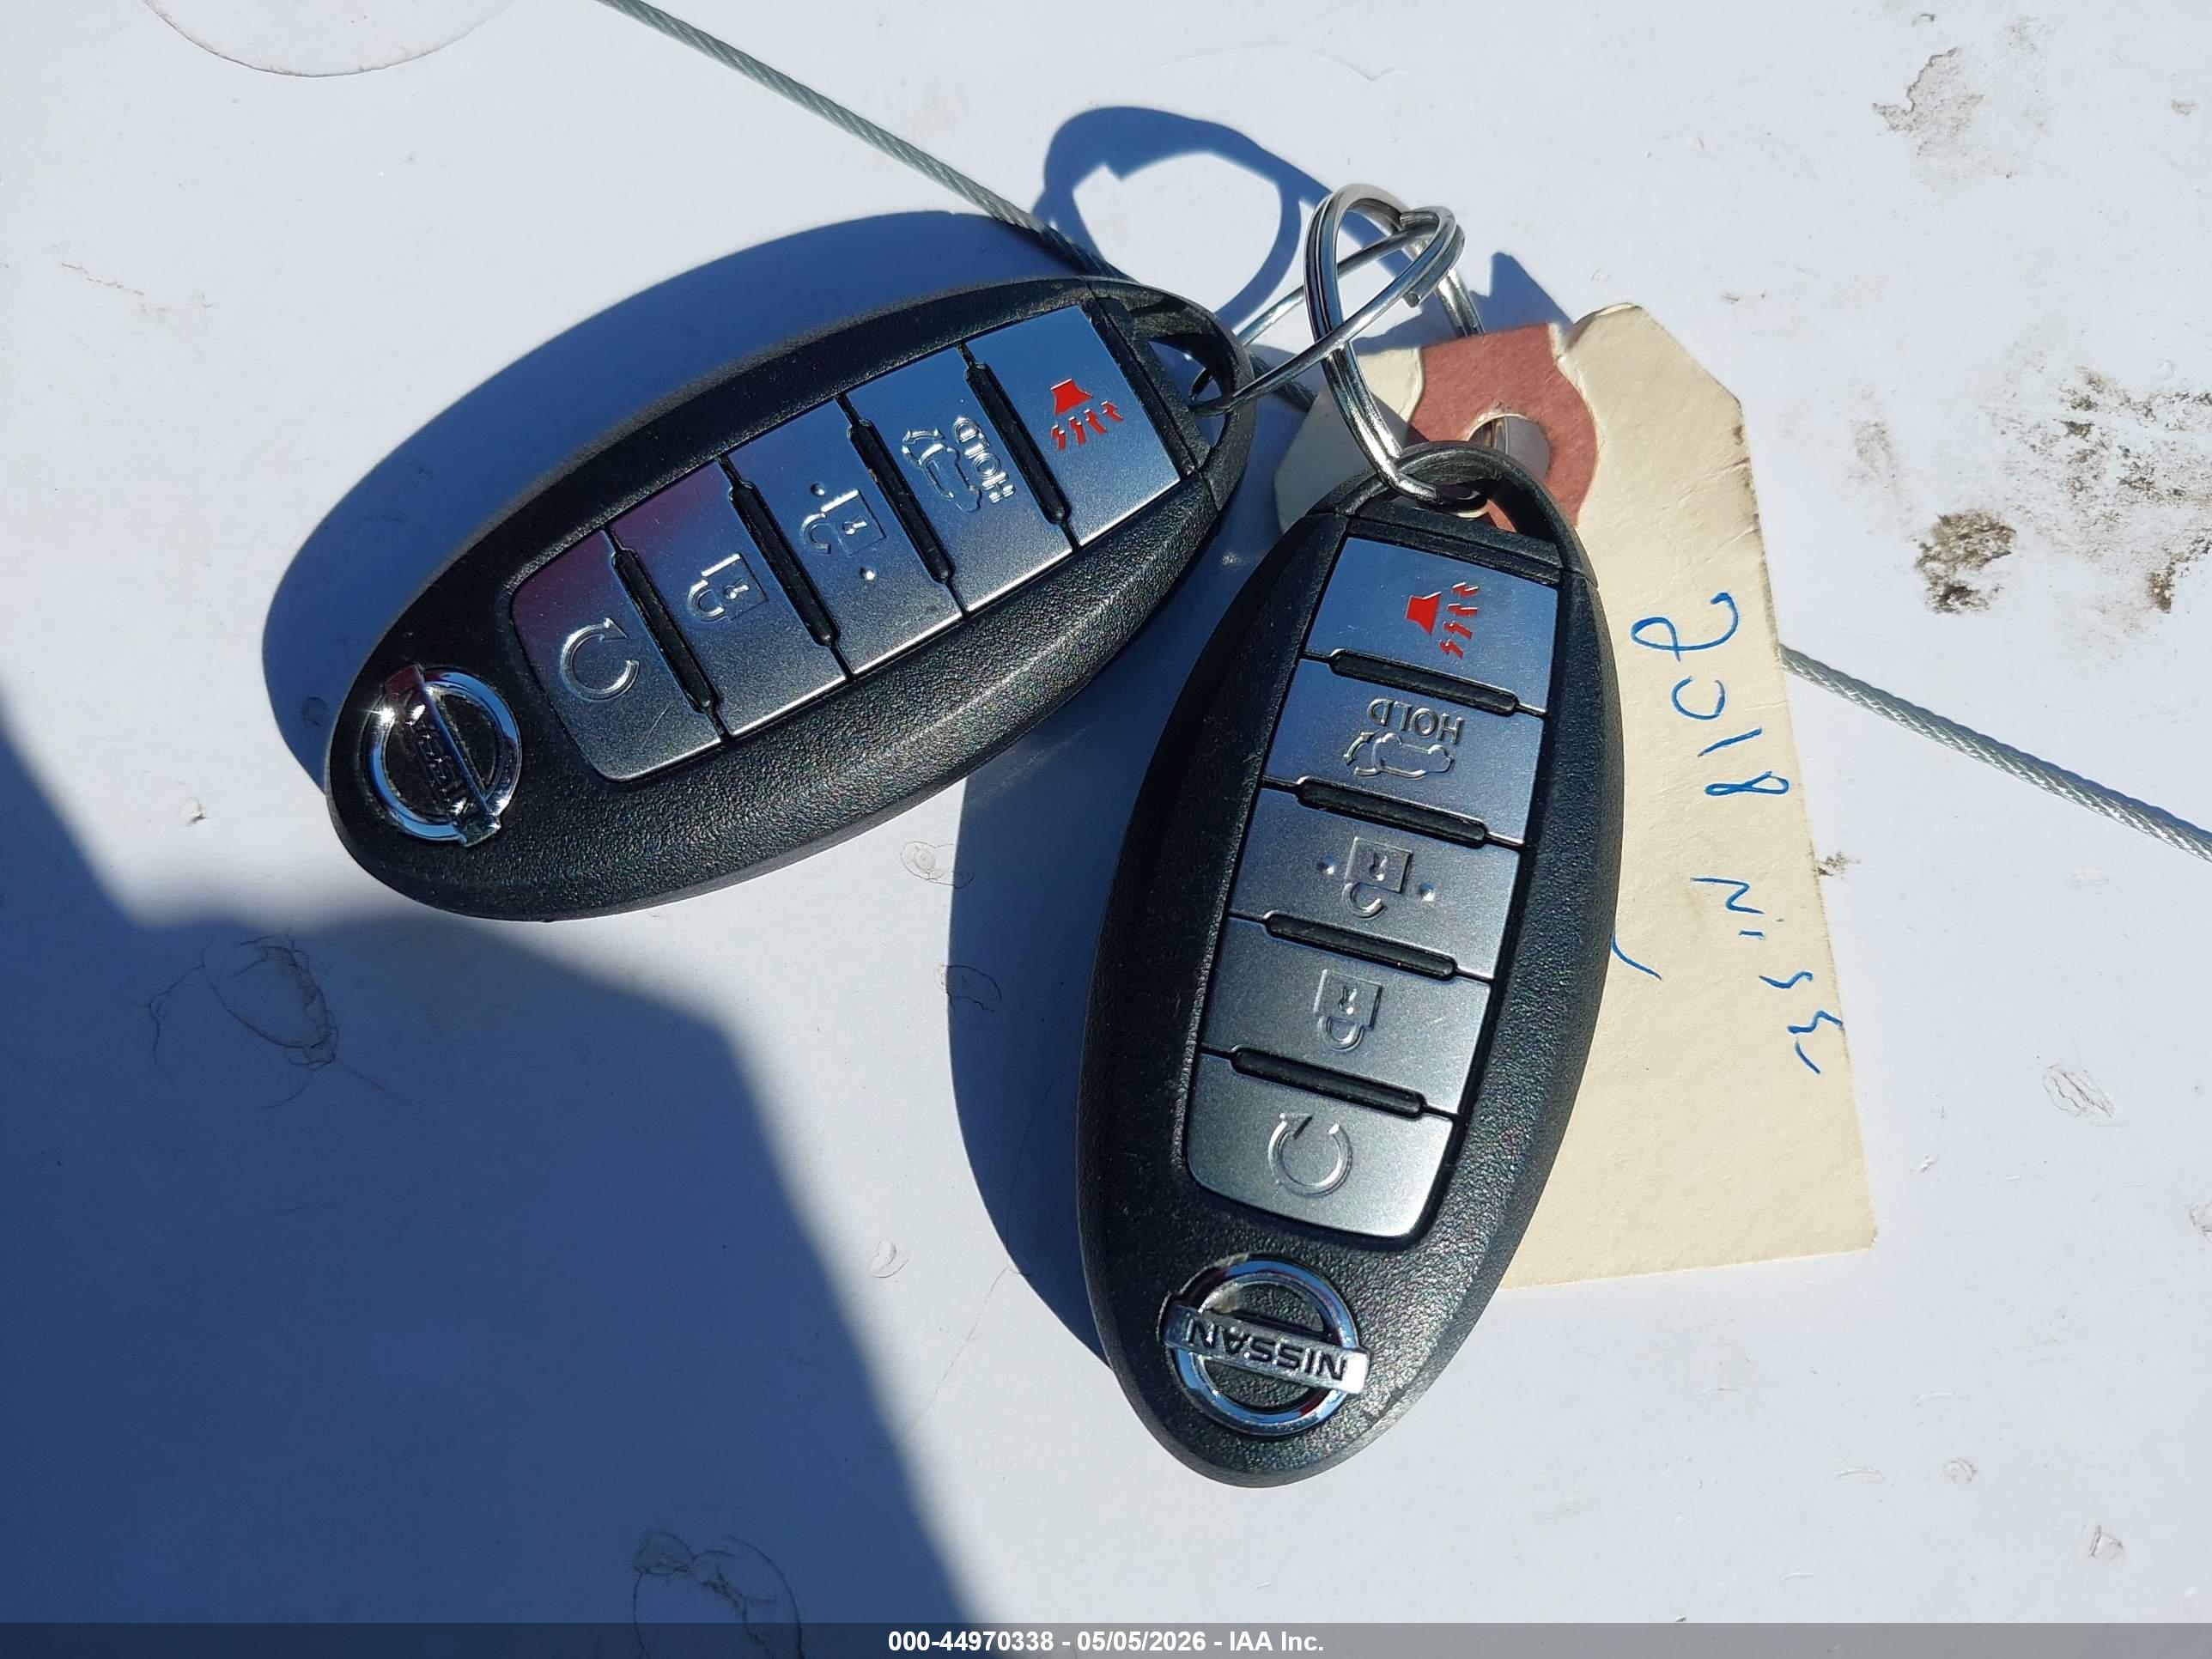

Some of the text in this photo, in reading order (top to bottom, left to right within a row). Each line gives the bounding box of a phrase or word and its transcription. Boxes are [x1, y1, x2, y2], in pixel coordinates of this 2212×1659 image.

[951, 416, 1017, 504] HOLD
[1365, 697, 1465, 745] HOLD
[1629, 590, 1791, 799] 2018
[1186, 1317, 1348, 1382] NISSAN
